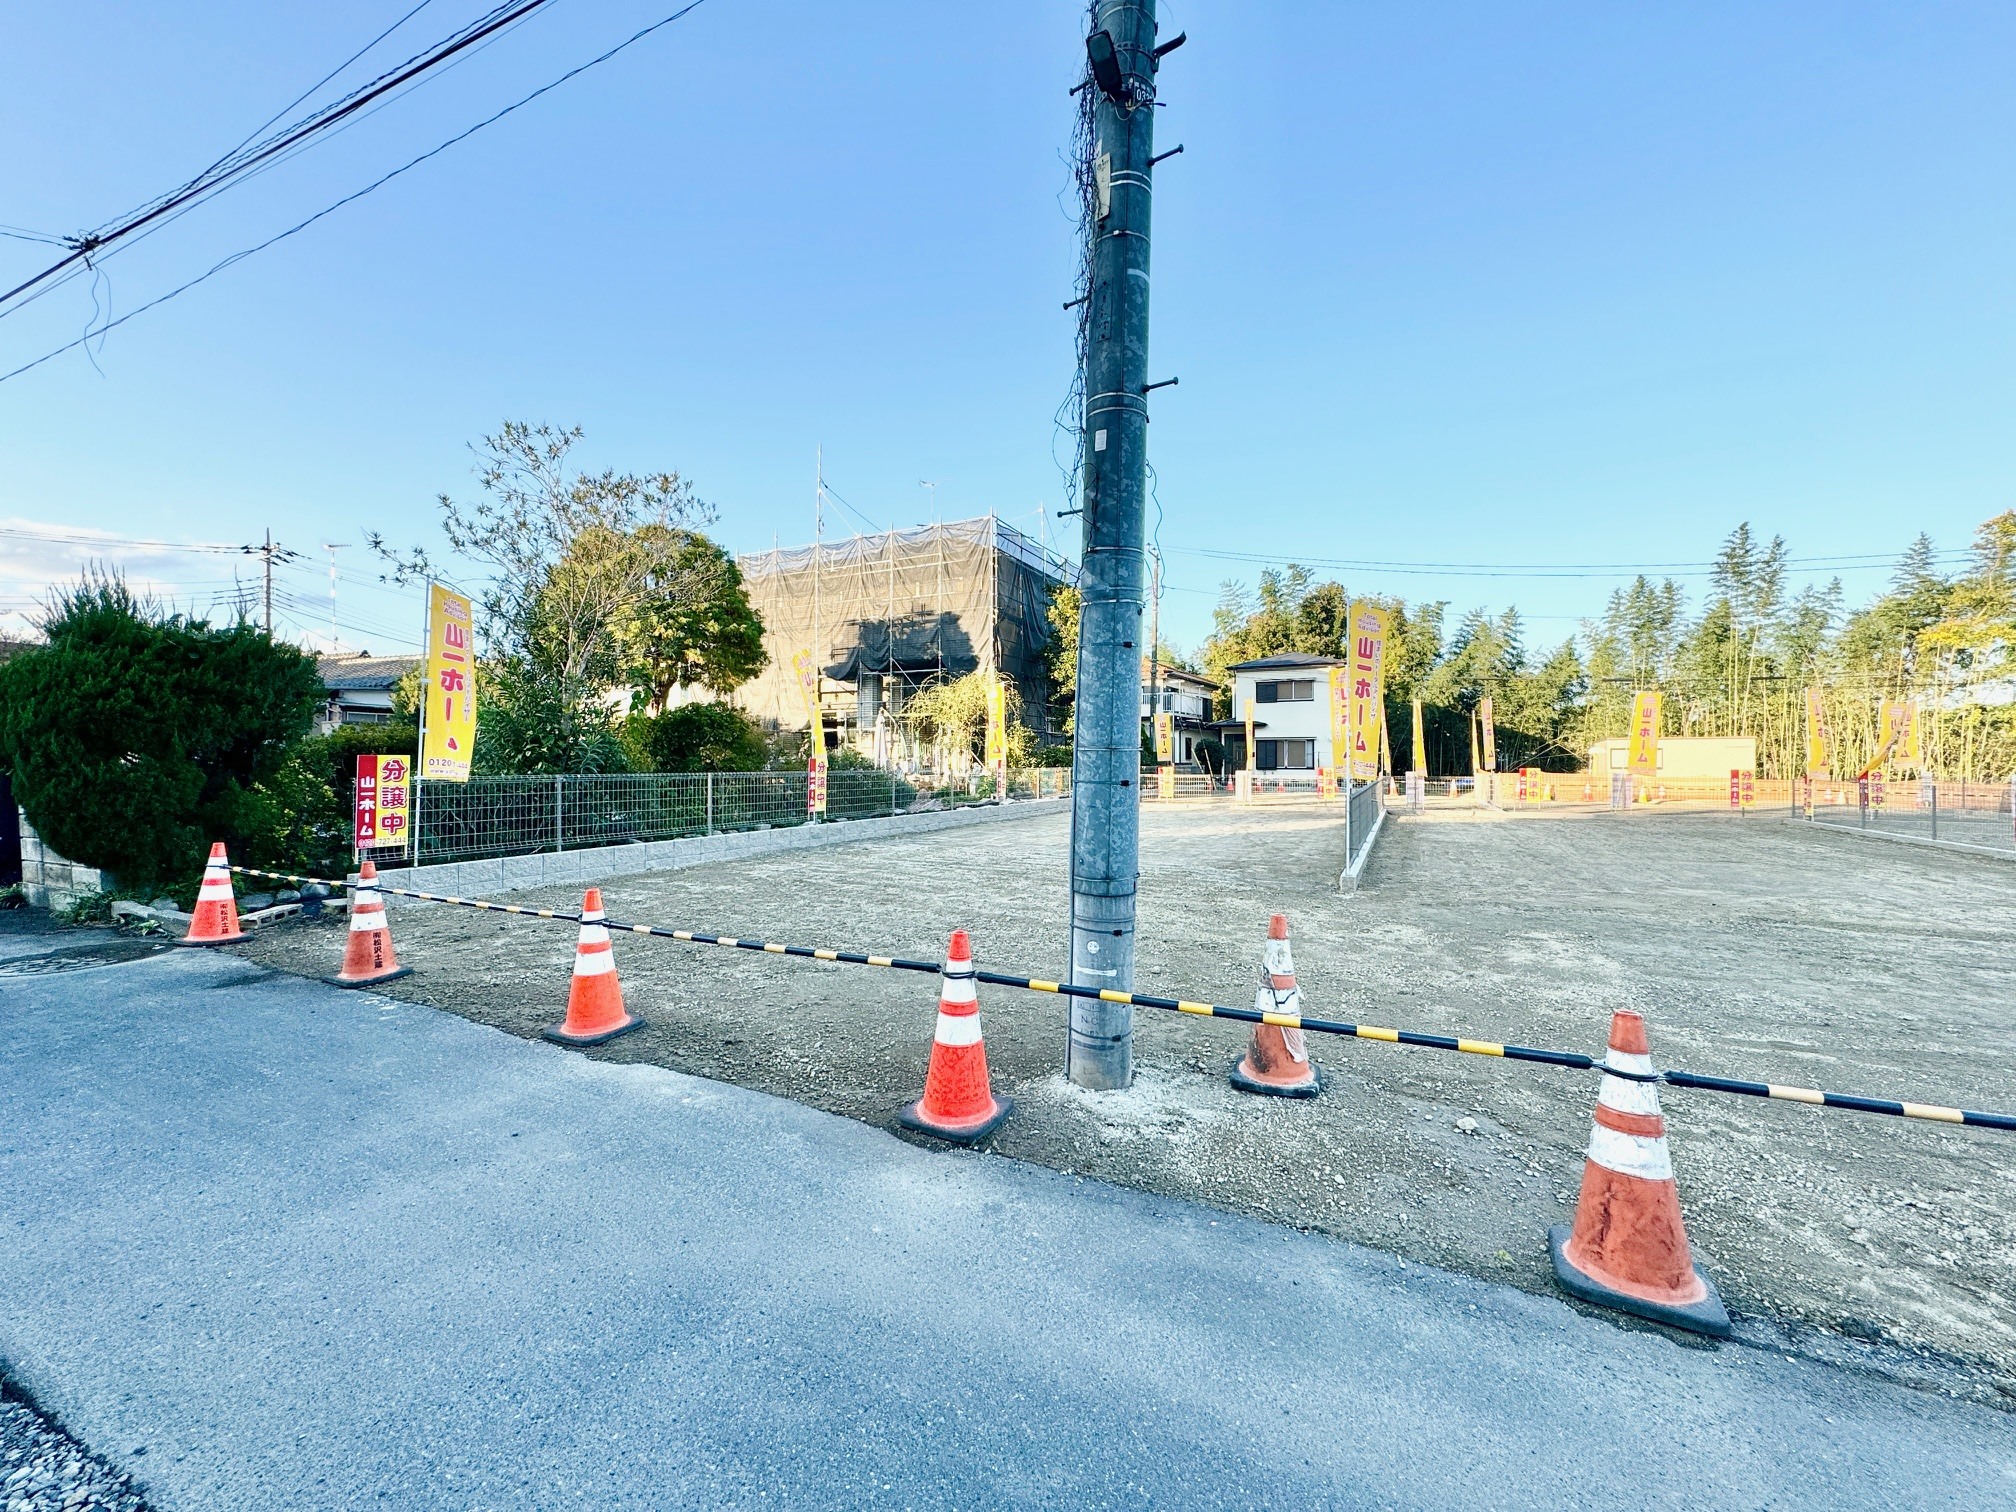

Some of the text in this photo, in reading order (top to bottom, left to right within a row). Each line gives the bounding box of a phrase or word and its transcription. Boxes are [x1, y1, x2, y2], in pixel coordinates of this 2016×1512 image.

[1355, 636, 1374, 753] 山一ホーム
[359, 775, 376, 836] 山一ホーム
[380, 758, 408, 836] 分譲中
